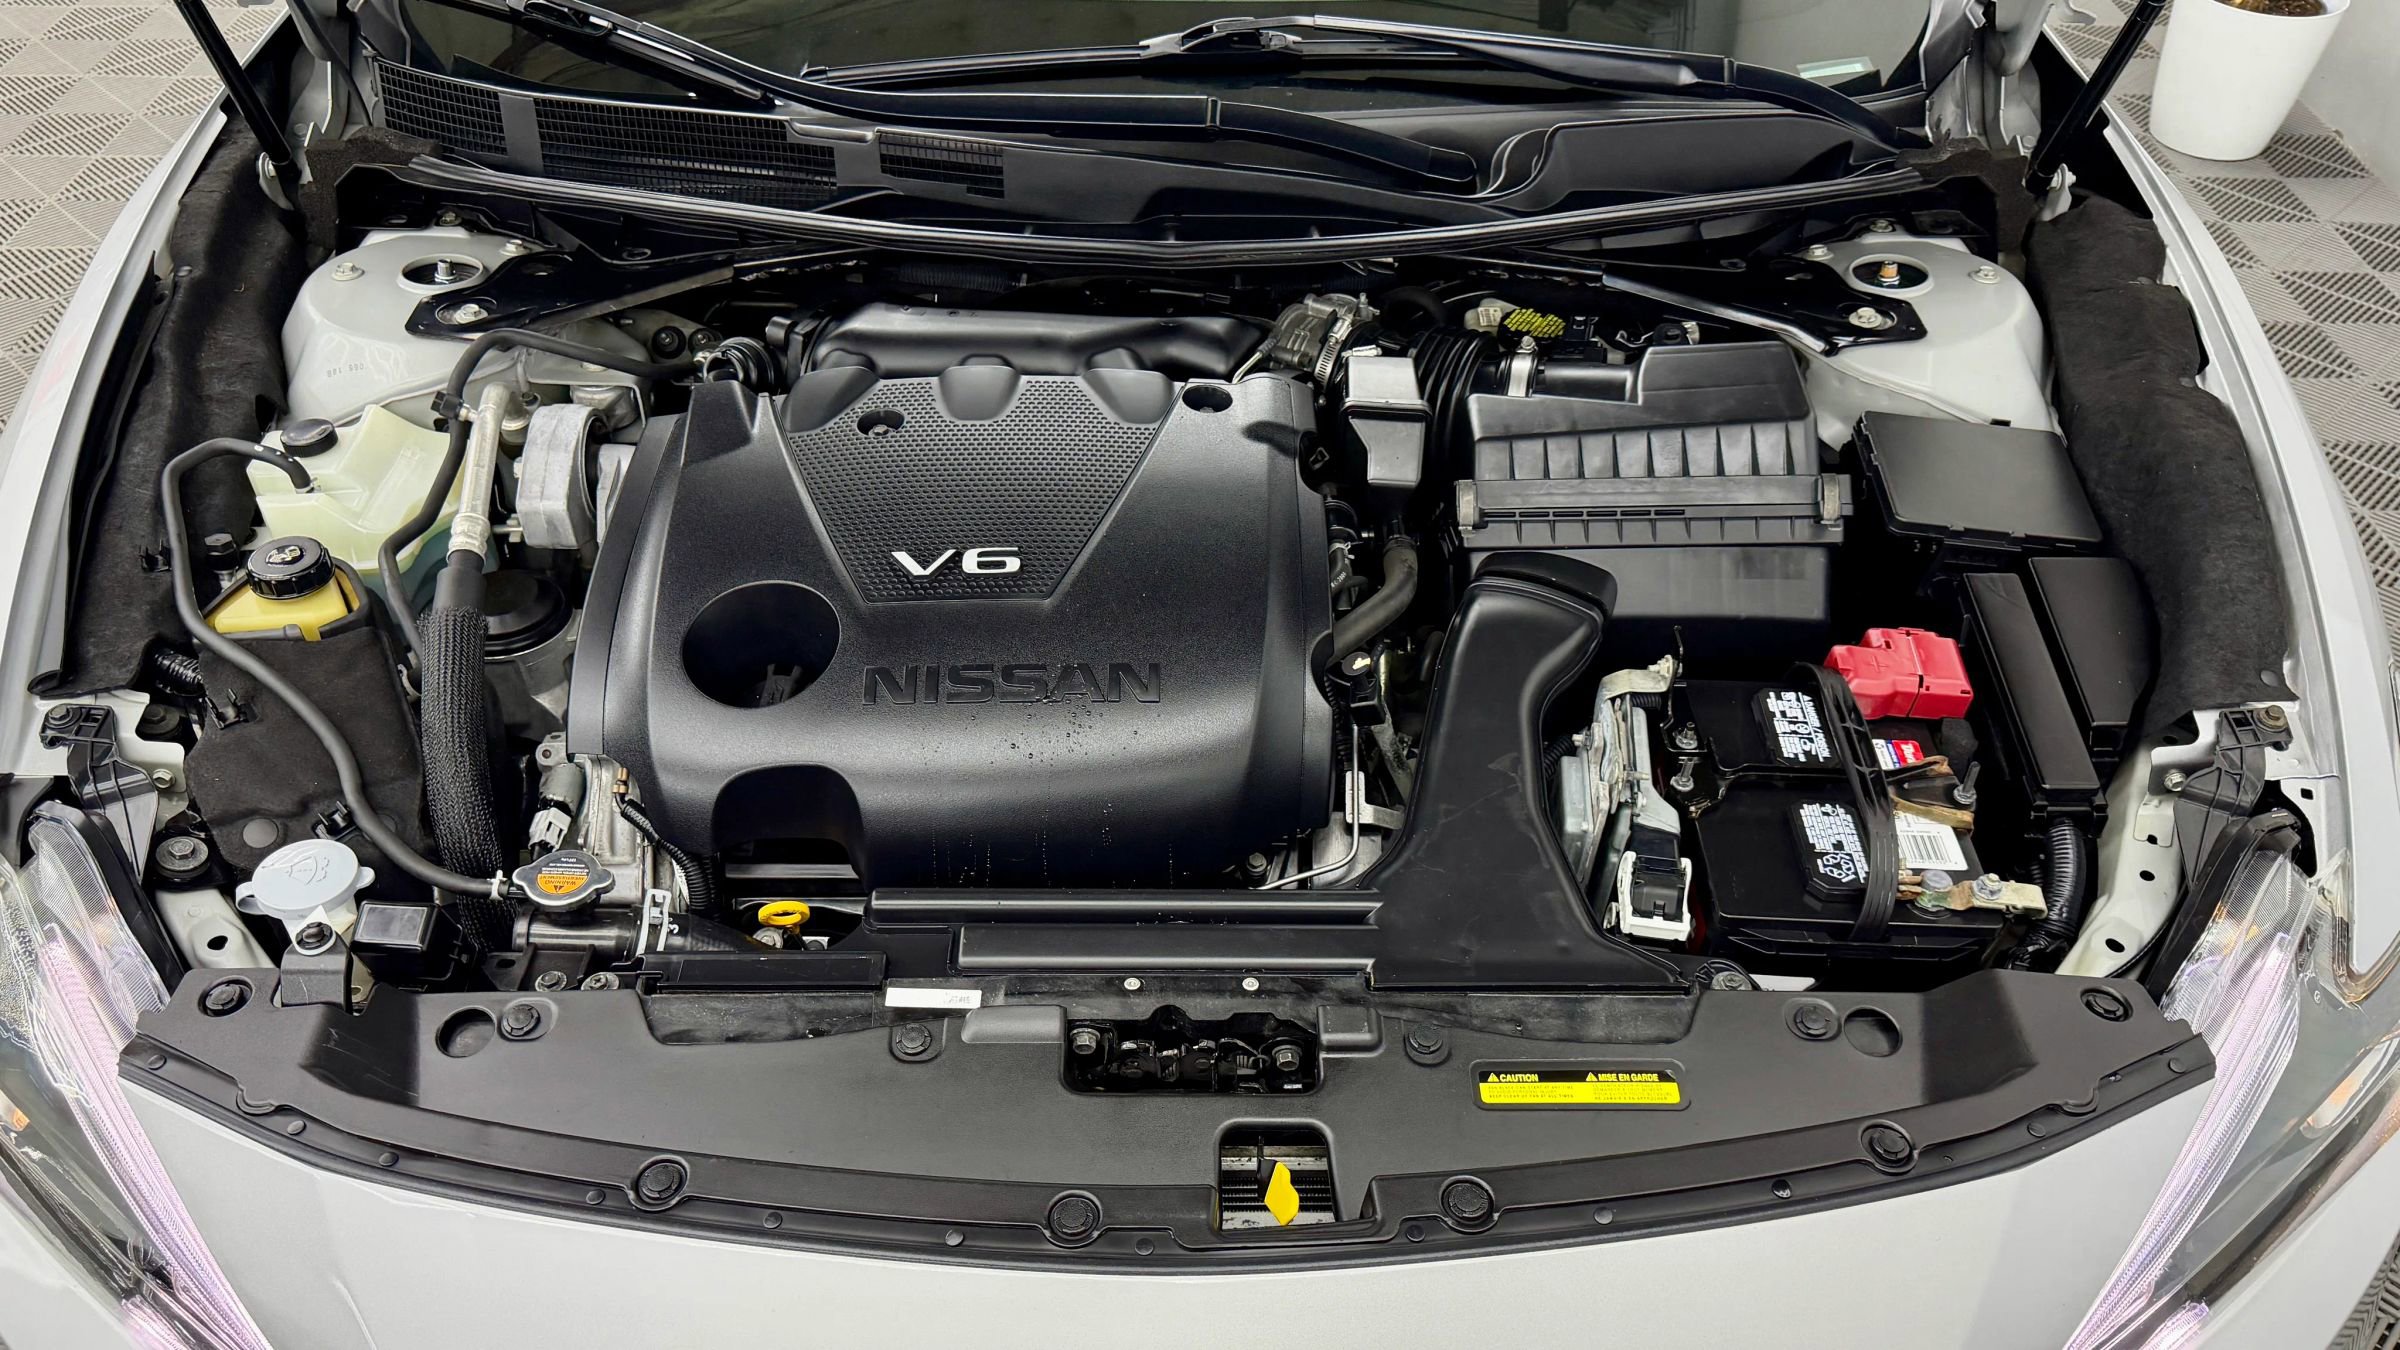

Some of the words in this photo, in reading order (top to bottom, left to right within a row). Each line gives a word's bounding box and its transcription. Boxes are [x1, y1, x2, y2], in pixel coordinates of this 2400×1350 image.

[891, 547, 1021, 576] V6
[862, 663, 1161, 704] NISSAN
[1804, 701, 1821, 728] DANGER
[1814, 732, 1831, 758] POISON
[1500, 1073, 1539, 1082] CAUTION
[1598, 1073, 1618, 1082] MISE
[1618, 1073, 1631, 1082] EN
[1631, 1073, 1660, 1082] GARDE
